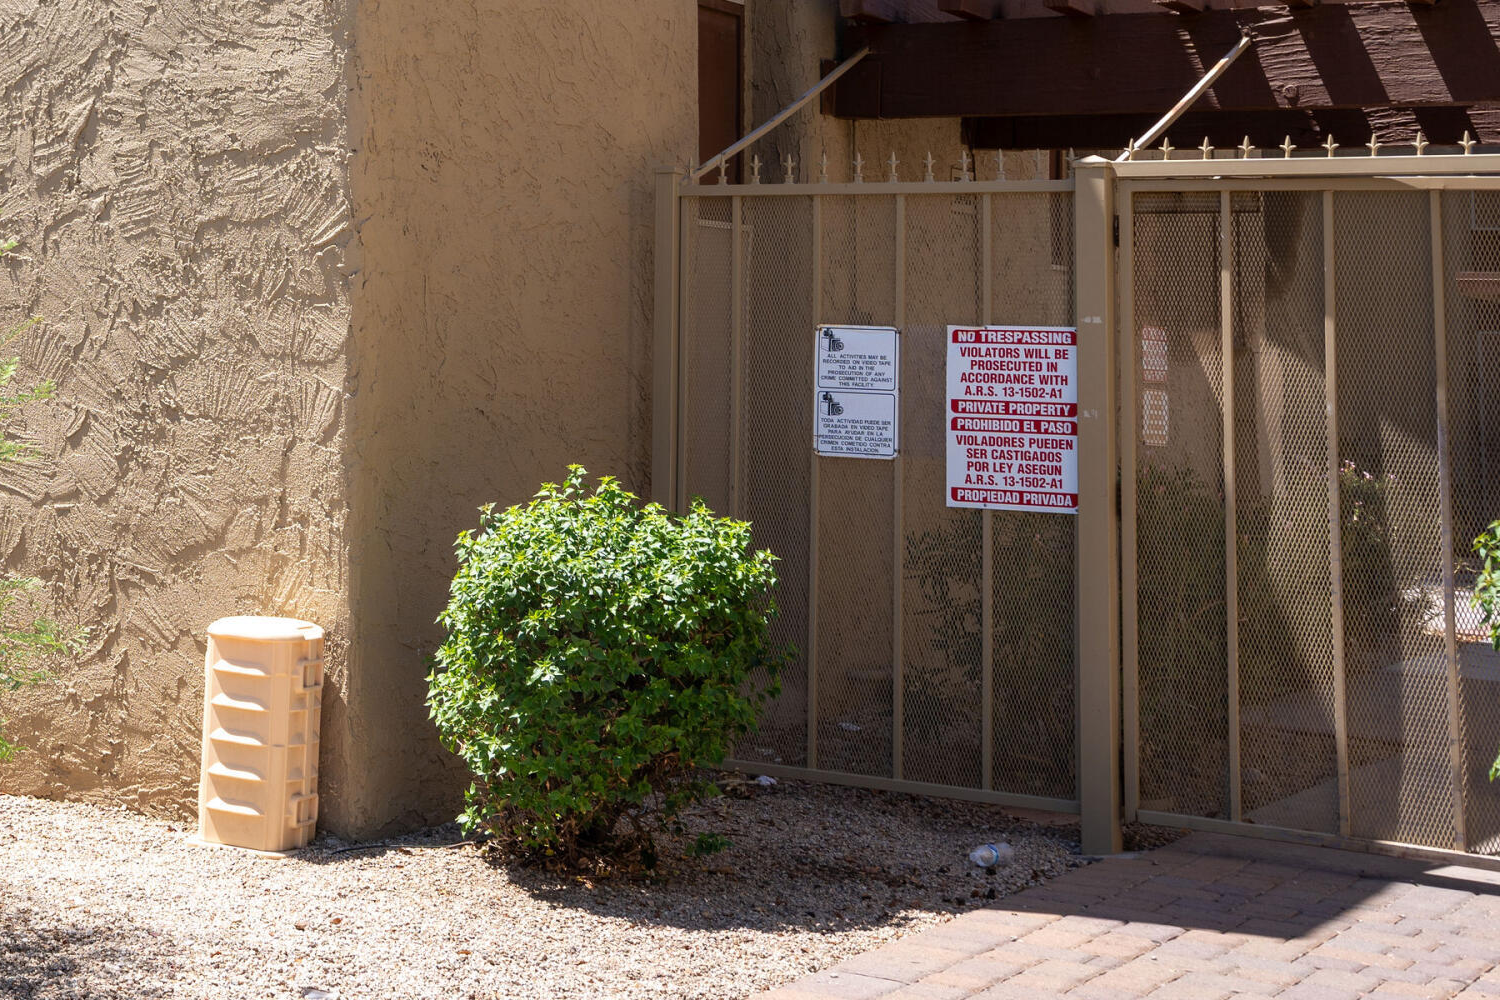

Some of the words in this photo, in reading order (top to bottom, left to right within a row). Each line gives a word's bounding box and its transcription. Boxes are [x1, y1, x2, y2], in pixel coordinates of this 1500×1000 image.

[958, 331, 975, 342] NO
[979, 331, 1071, 344] TRESPASSING
[960, 347, 1020, 358] VIOLATORS
[1024, 349, 1050, 359] WILL
[1055, 349, 1069, 359] BE
[971, 360, 1042, 372] PROSECUTED
[1047, 362, 1057, 372] IN
[961, 373, 1034, 384] ACCORDANCE
[1038, 375, 1068, 385] WITH
[965, 386, 997, 397] A.R.S.
[1002, 387, 1062, 399] 13-1502-A1
[958, 401, 1005, 414] PRIVATE
[1009, 403, 1070, 416] PROPERTY
[957, 419, 1020, 432] PROHIBIDO
[1023, 421, 1036, 432] EL
[1041, 422, 1071, 433] PASO
[956, 435, 1025, 448] VIOLADORES
[1029, 437, 1073, 450] PUEDEN
[967, 449, 987, 459] SER
[991, 449, 1062, 462] CASTIGADOS
[967, 461, 989, 472] POR
[993, 463, 1013, 473] LEY
[1017, 464, 1062, 475] ASEGUN
[965, 474, 998, 485] A.R.S.
[1003, 476, 1062, 489] 13-1502-A1
[957, 489, 1019, 503] PROPIEDAD
[1023, 492, 1072, 506] PRIVADA
